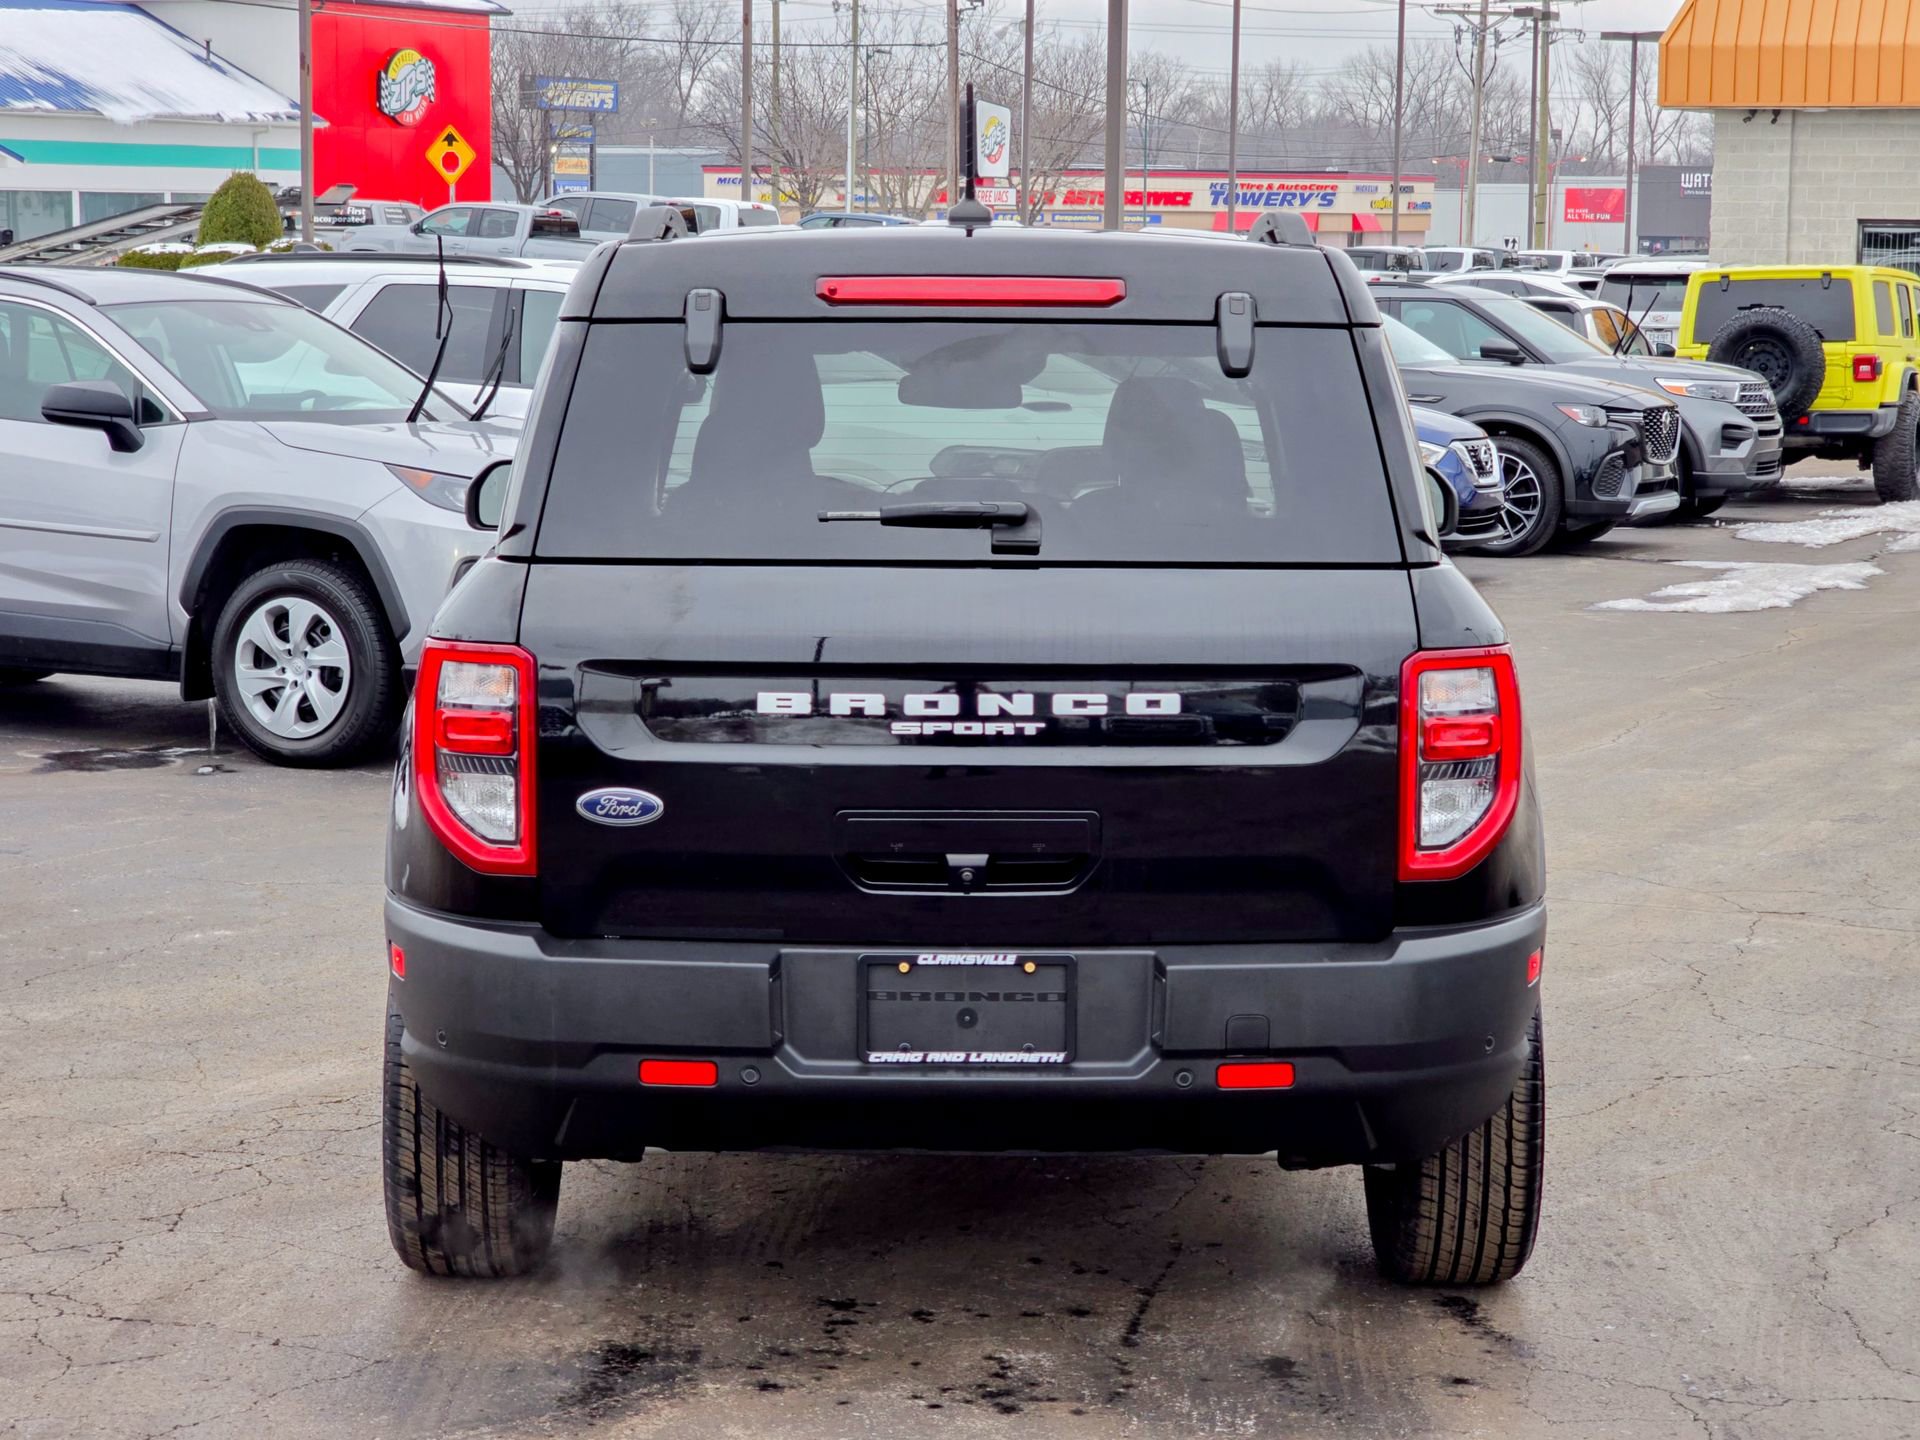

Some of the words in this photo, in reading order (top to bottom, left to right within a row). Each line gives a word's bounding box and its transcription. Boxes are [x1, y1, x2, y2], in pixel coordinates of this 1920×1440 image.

[389, 63, 427, 112] ZIPS
[1681, 173, 1713, 188] WAT
[1240, 183, 1263, 191] Tire
[1266, 183, 1274, 191] &
[1276, 184, 1339, 192] AutoCare
[977, 190, 993, 203] FREE
[994, 190, 1009, 203] VACS
[1209, 191, 1337, 208] TOWERY'S
[347, 206, 367, 216] First
[313, 214, 366, 225] ncorporated
[757, 692, 1181, 716] BRONCO
[891, 722, 1046, 735] SPORT
[596, 795, 642, 816] Ford
[917, 954, 1017, 965] CLARKSVILLE
[868, 991, 1067, 1002] BRONCO
[869, 1052, 923, 1062] CRAIG
[926, 1052, 966, 1062] AND
[969, 1052, 1066, 1063] LANDRETH
